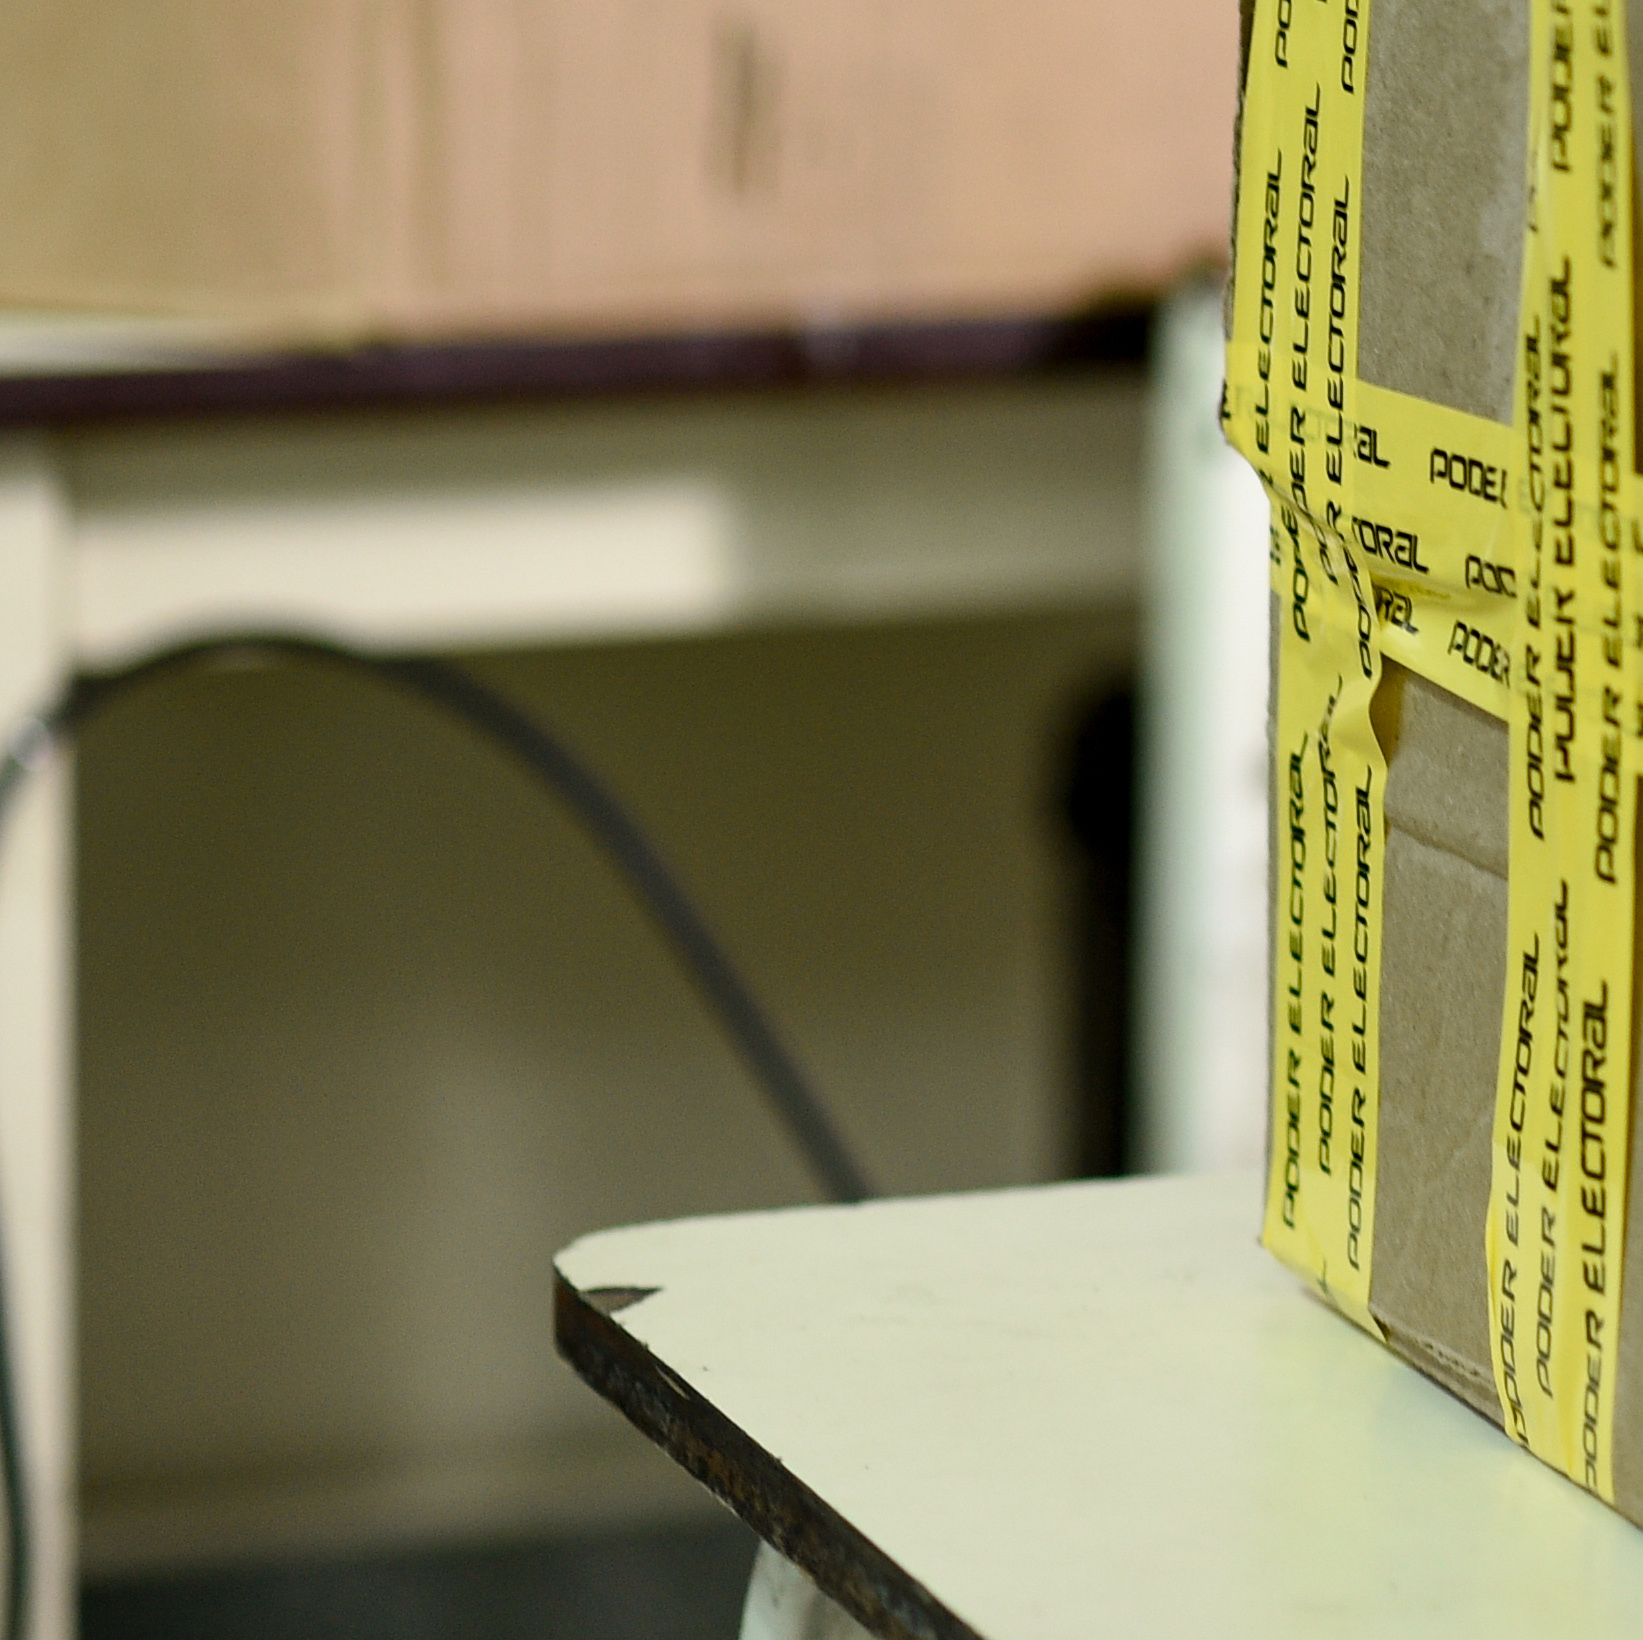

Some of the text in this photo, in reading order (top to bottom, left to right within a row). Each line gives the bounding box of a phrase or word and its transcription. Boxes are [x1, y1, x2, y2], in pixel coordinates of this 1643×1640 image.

[1256, 149, 1283, 455] ELECTORAL
[1290, 82, 1321, 391] ELECTORAL
[1326, 176, 1350, 485] ELECTORAL
[1525, 315, 1546, 842] PODER ELECTORAL
[1595, 352, 1622, 885] PODER ELECTORAL
[1283, 733, 1308, 1230] PODER ELECTORAL
[1319, 991, 1335, 1176] PODER
[1348, 764, 1372, 1271] PODER ELECTORAL
[1579, 979, 1608, 1297] ELECTORAL
[1500, 931, 1540, 1447] PODER ELECTORAL
[1536, 1206, 1557, 1400] PODER
